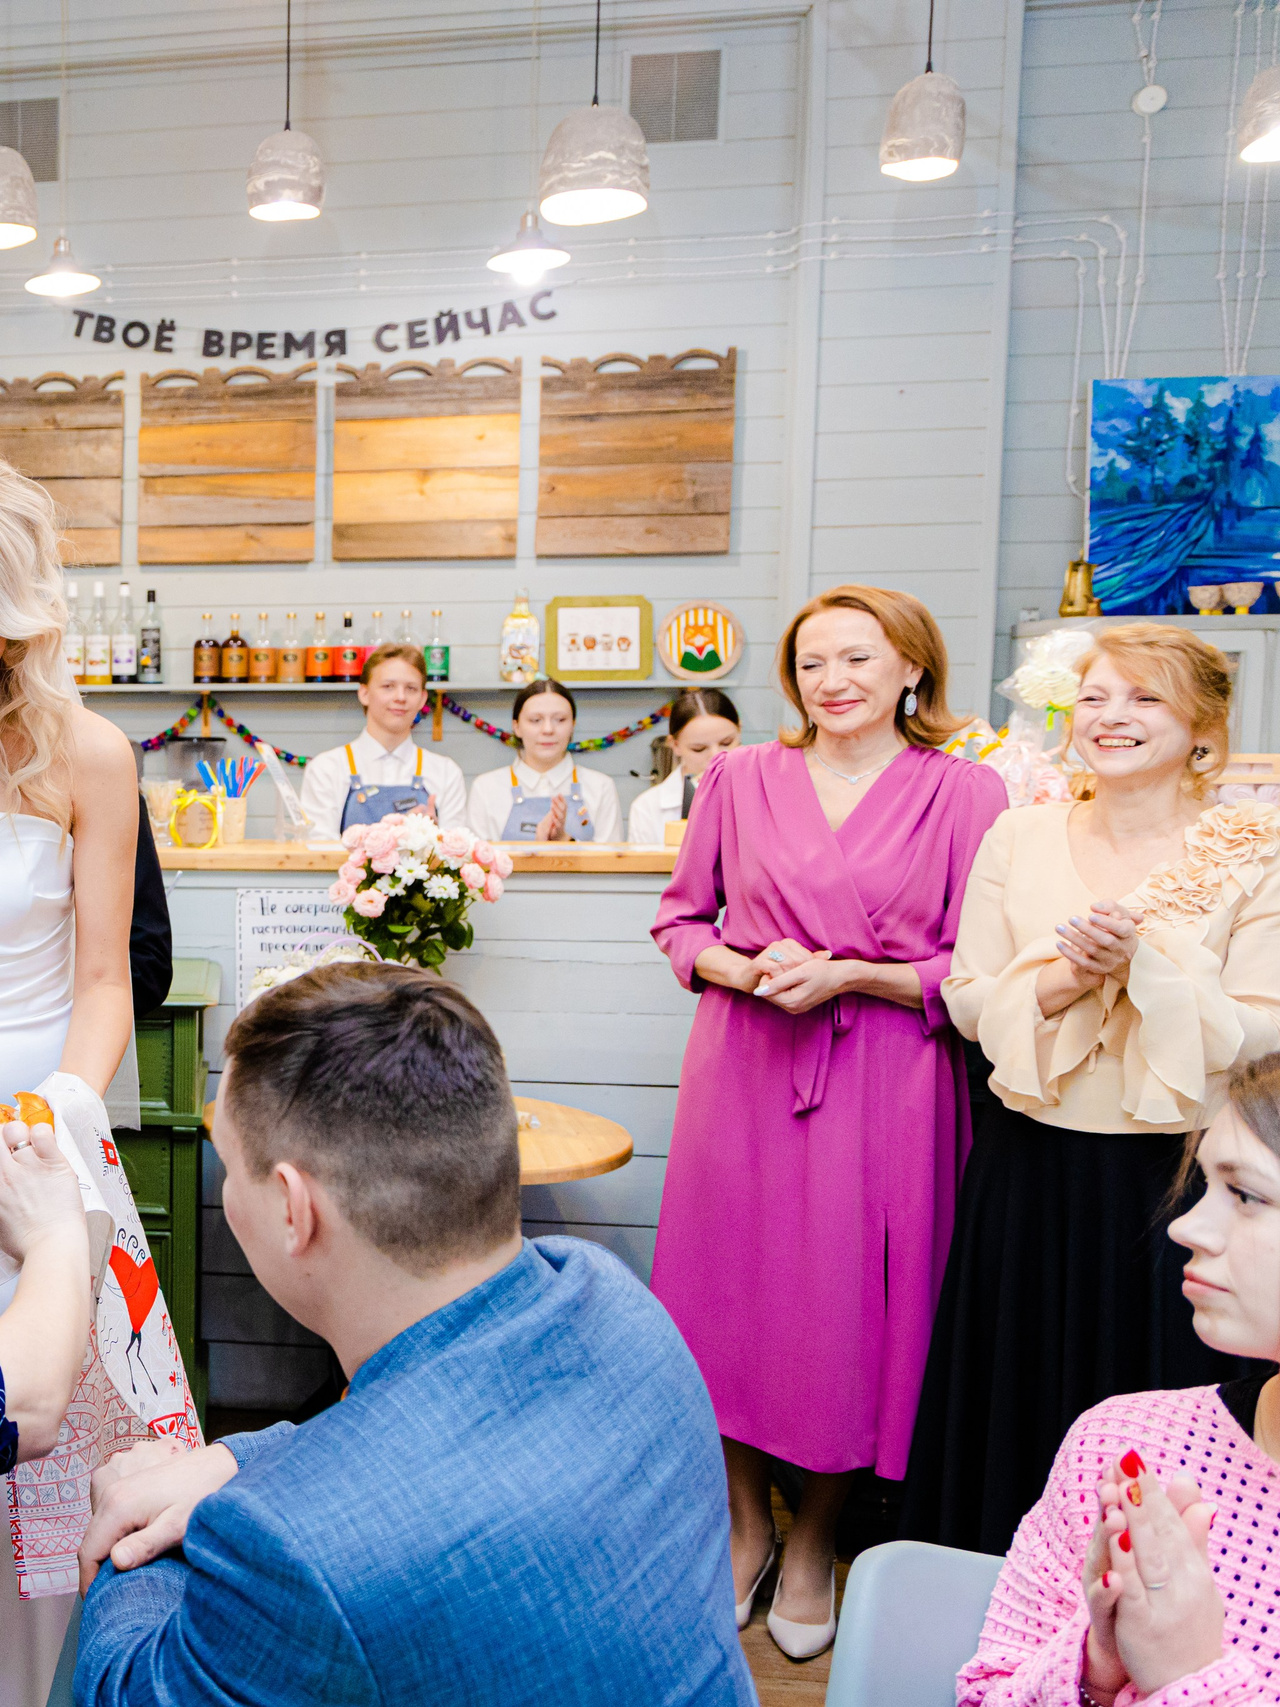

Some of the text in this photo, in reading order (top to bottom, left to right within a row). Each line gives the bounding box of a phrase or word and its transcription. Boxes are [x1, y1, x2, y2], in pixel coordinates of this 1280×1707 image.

[73, 290, 557, 359] ТВОЁ ВРЕМЯ СЕЙЧАС
[260, 896, 277, 916] Не
